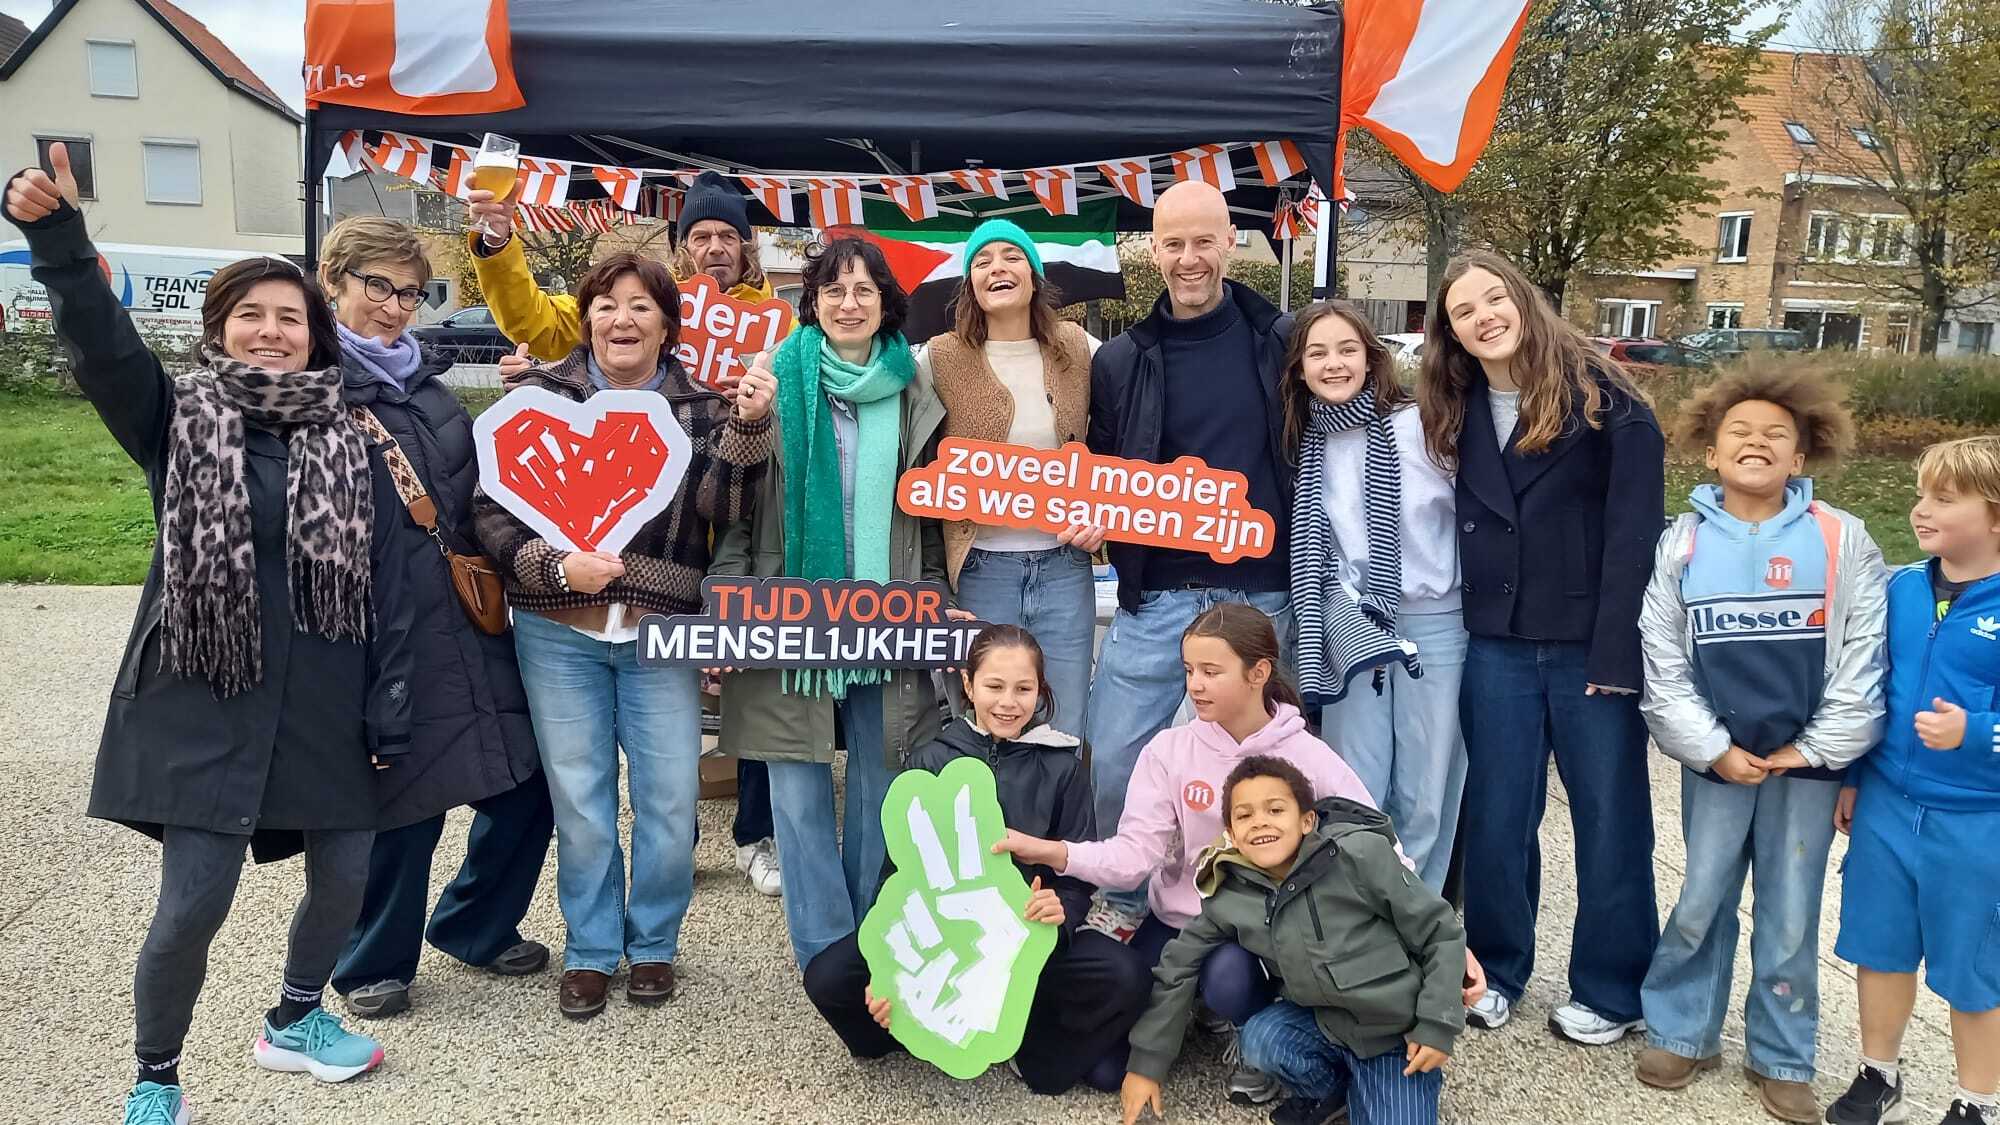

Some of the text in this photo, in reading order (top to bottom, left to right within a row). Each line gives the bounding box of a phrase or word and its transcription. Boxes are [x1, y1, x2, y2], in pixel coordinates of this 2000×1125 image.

[144, 276, 209, 293] TRANS
[151, 293, 190, 309] SOL
[946, 446, 1237, 507] zoveel mooier
[908, 473, 1265, 554] als we samen zijn
[711, 584, 942, 624] T1JD VOOR
